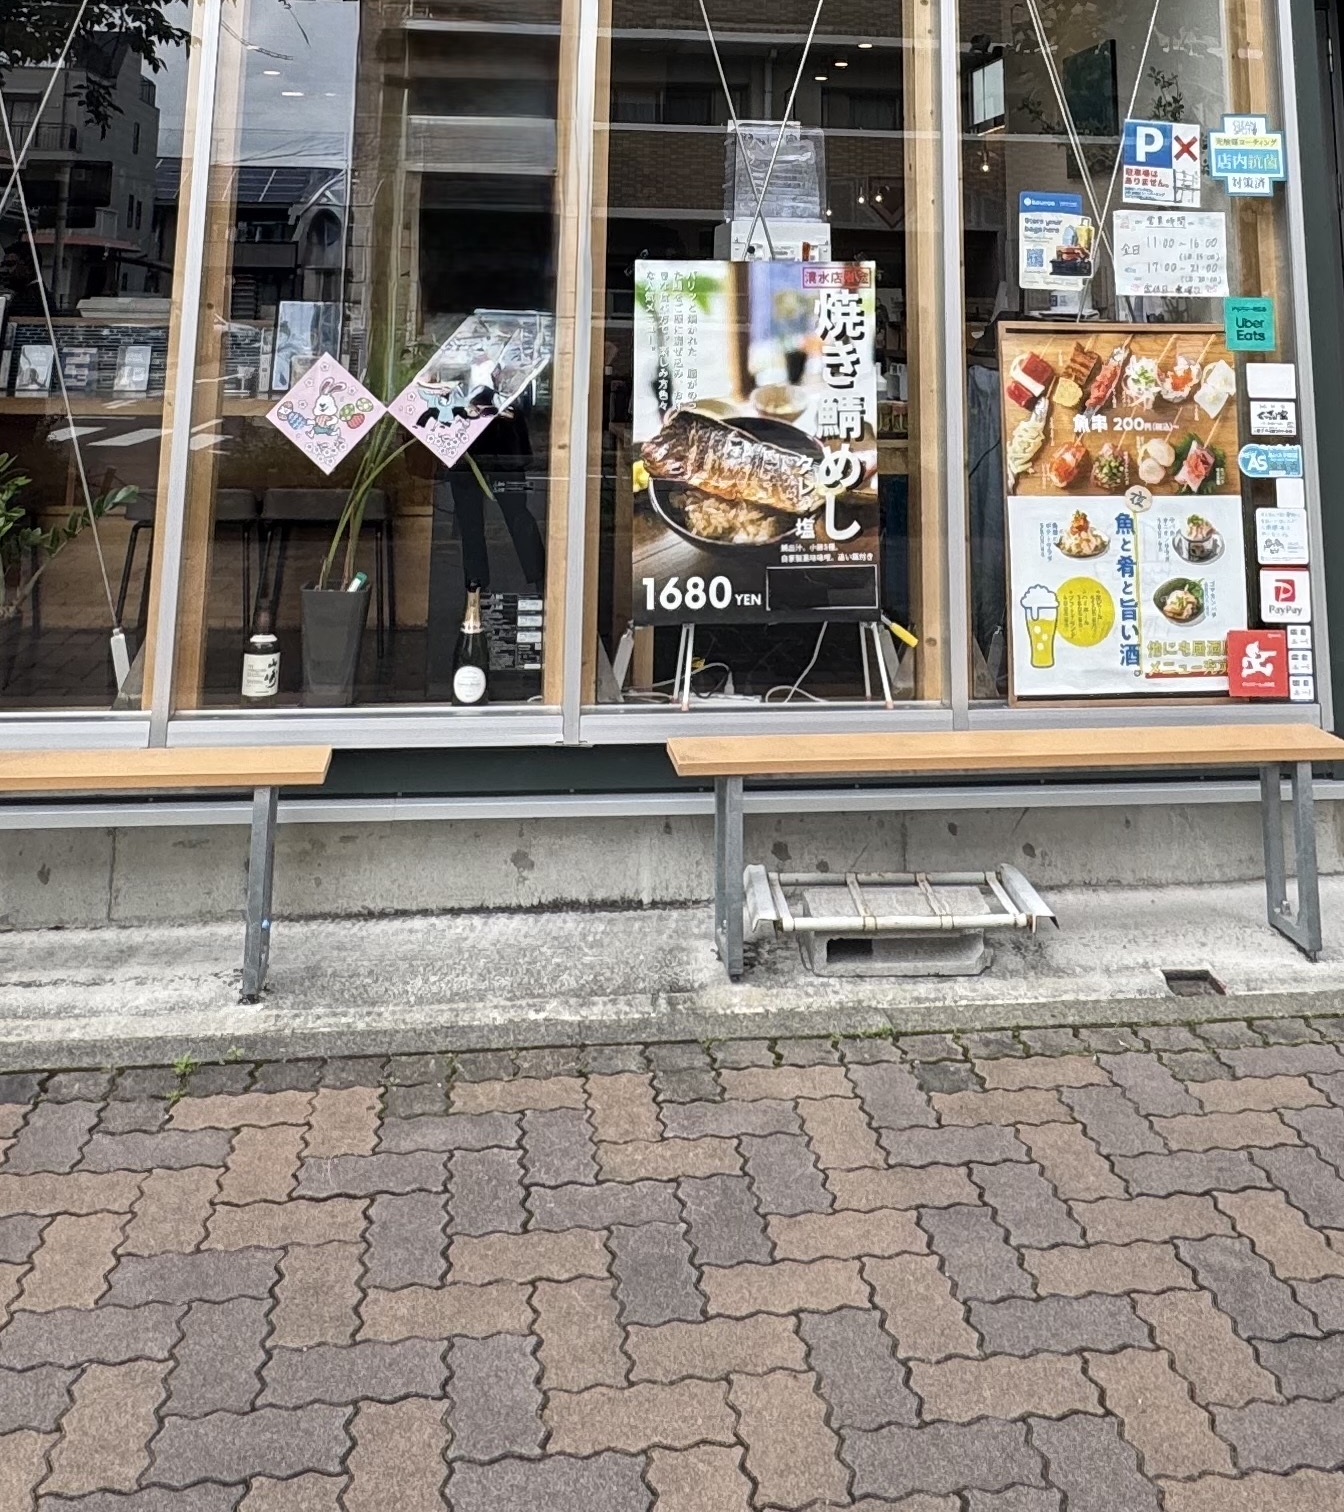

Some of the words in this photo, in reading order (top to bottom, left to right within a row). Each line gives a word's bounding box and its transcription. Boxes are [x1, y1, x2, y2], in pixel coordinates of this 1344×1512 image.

[1136, 125, 1164, 163] P
[1236, 316, 1265, 329] Uber
[1236, 329, 1266, 342] Eats
[814, 289, 868, 541] 焼き鯖めし
[1072, 413, 1108, 433] 魚串
[641, 575, 733, 611] 1680
[735, 593, 762, 607] YEN
[1268, 605, 1303, 616] PayPay
